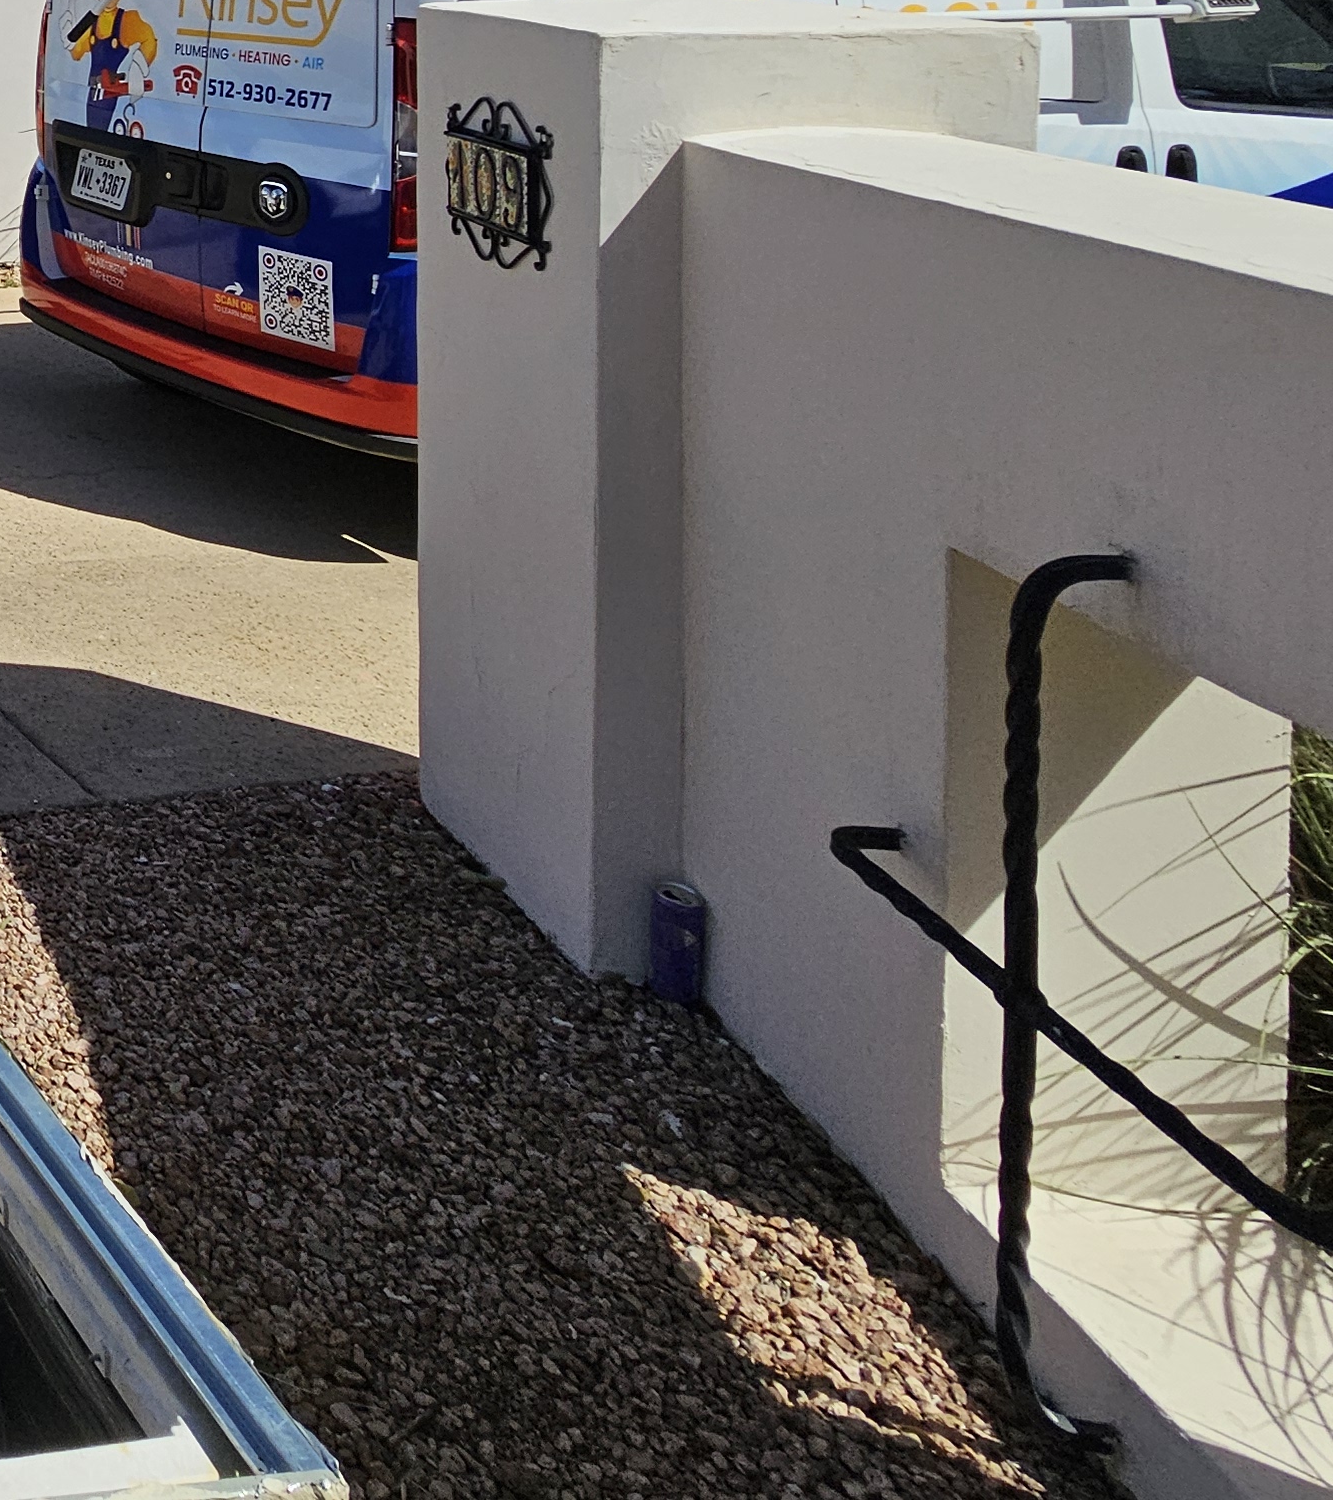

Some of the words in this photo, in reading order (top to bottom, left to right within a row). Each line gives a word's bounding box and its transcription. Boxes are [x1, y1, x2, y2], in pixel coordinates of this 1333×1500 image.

[175, 43, 229, 60] PLUMBING
[238, 50, 292, 66] HEATING
[302, 56, 325, 70] AIR
[207, 78, 333, 112] 512-930-2677
[95, 155, 116, 170] TEXAS
[451, 140, 523, 231] 109
[215, 293, 239, 309] SCAN
